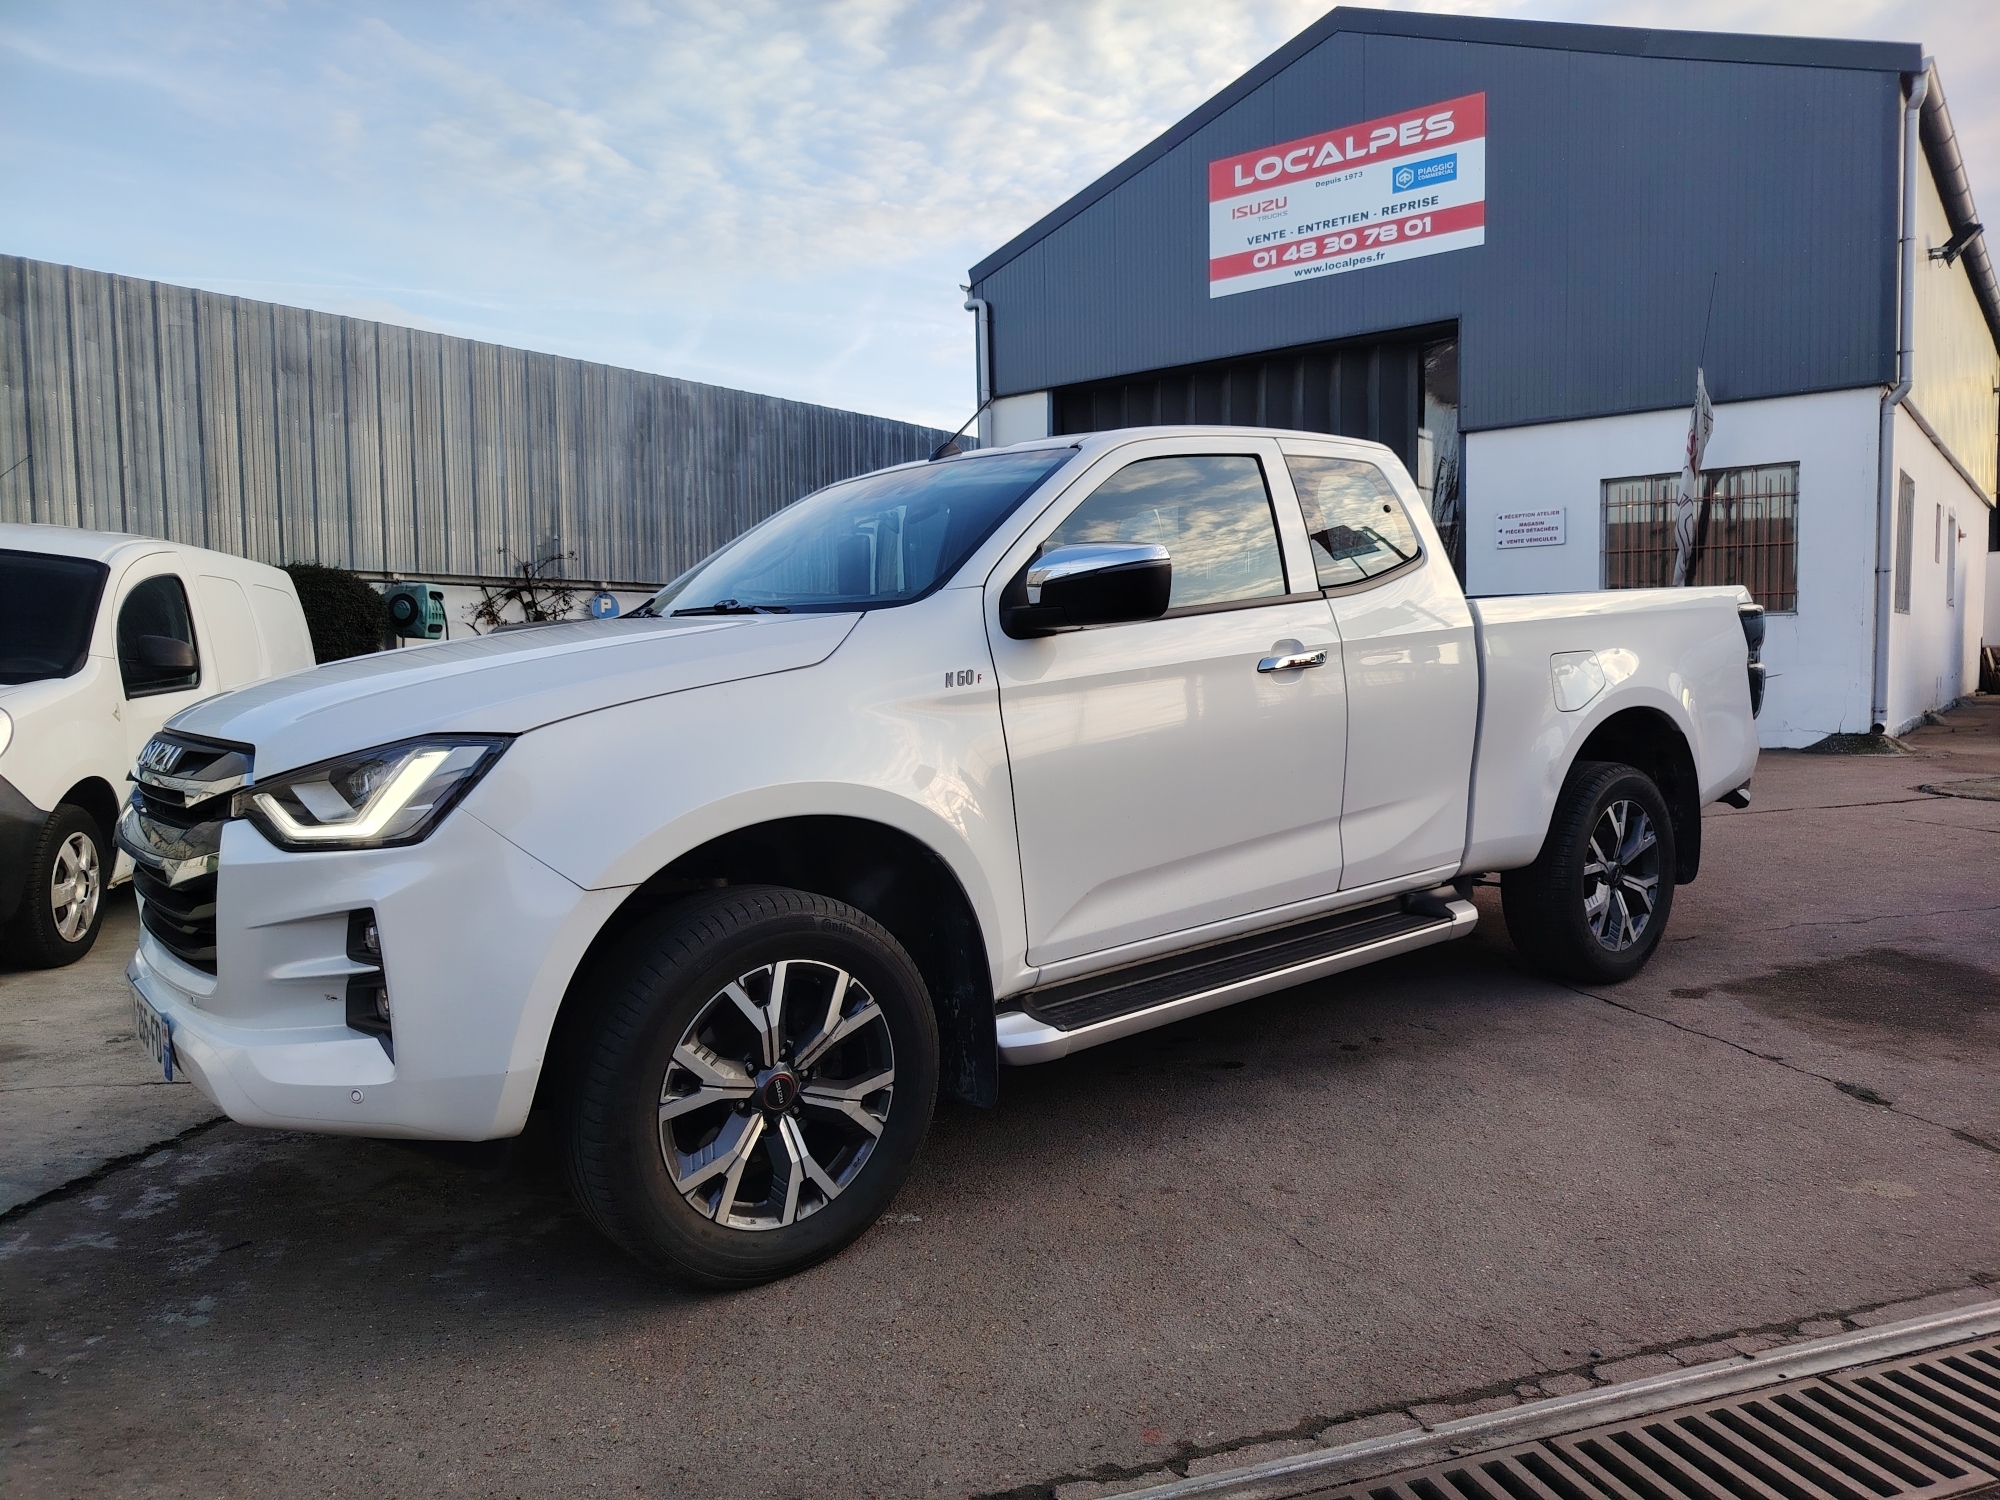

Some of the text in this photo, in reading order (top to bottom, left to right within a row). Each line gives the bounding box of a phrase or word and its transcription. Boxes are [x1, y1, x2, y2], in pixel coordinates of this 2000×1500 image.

[1234, 111, 1455, 188] LOC'ALPES
[1418, 161, 1454, 176] PIAGGIO
[1418, 169, 1454, 181] COMMERCIAL
[1315, 171, 1363, 188] Depuis 1973
[1232, 196, 1288, 220] ISUZU
[1257, 210, 1288, 222] TRUCKS
[1247, 229, 1287, 246] VENTE
[1297, 210, 1369, 235] ENTRETIEN
[1381, 195, 1439, 217] REPRISE
[1253, 216, 1432, 268] 01 48 30 78 01
[1294, 251, 1386, 277] www.localpes.fr
[600, 598, 612, 614] P
[977, 674, 982, 684] F
[775, 1079, 784, 1104] ISUZU
